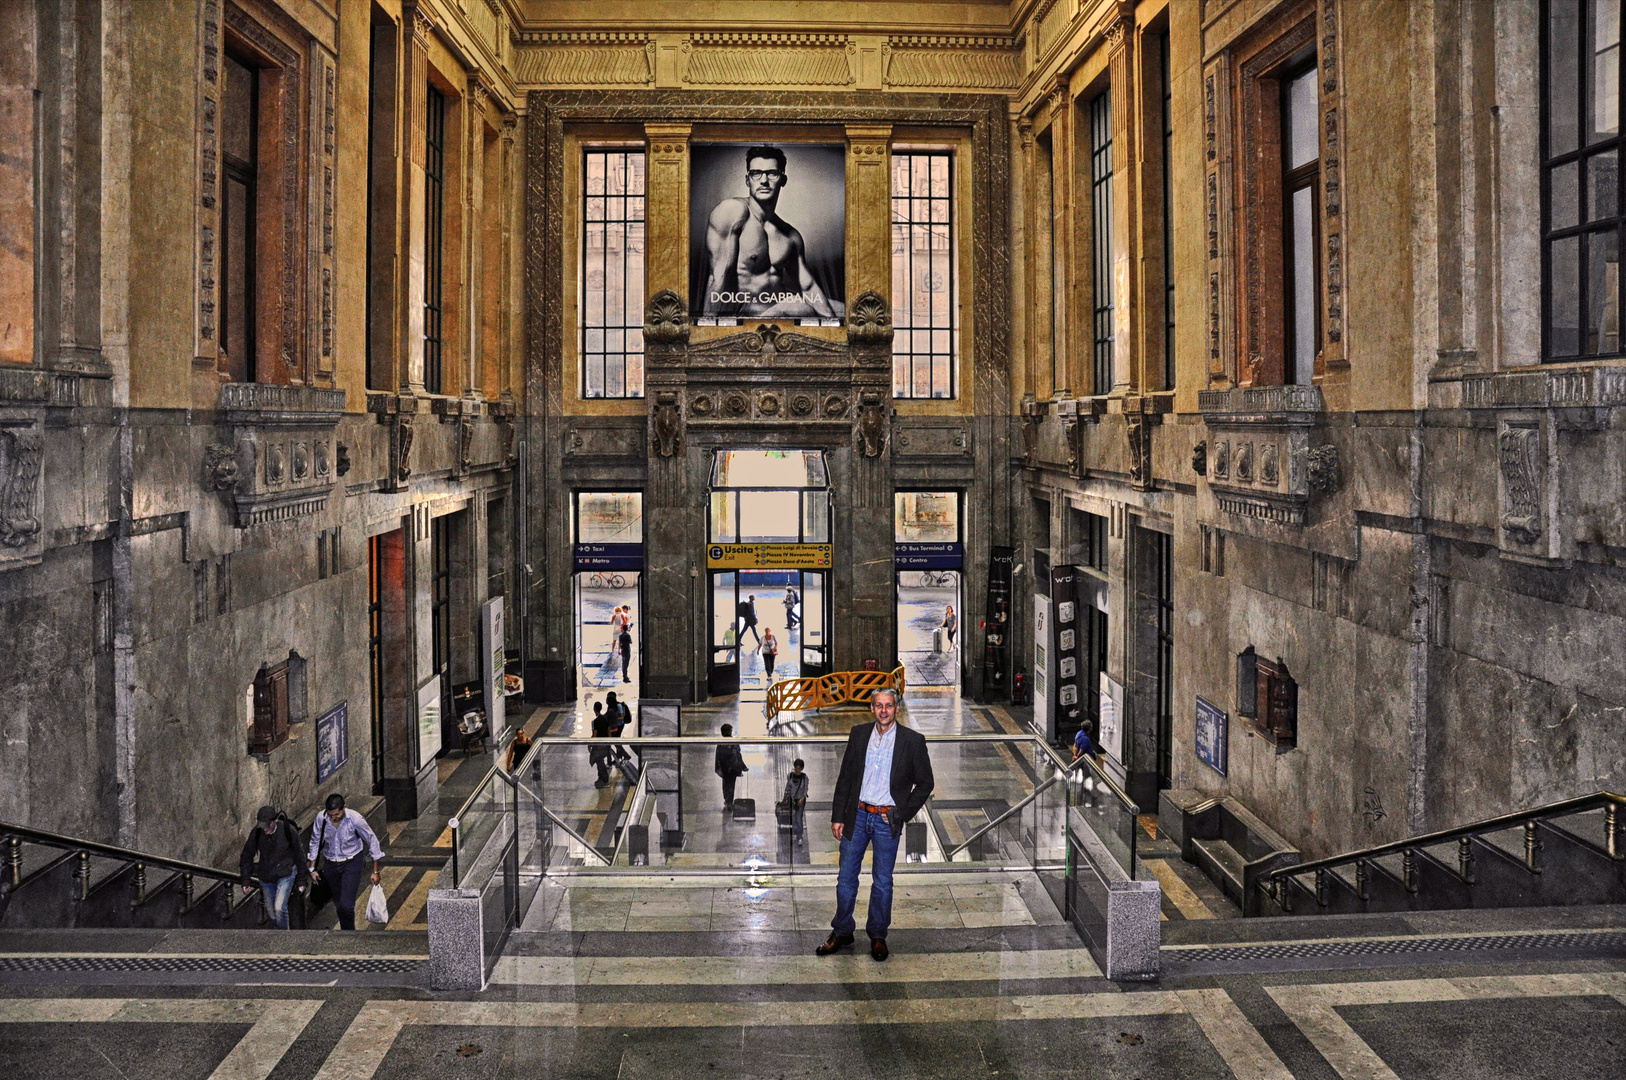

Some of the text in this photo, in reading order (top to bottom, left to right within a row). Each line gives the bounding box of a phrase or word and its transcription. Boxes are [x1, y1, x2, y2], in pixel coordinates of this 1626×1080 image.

[710, 291, 751, 304] DOLCE
[758, 291, 823, 304] GABBANA
[724, 545, 754, 554] Uscita
